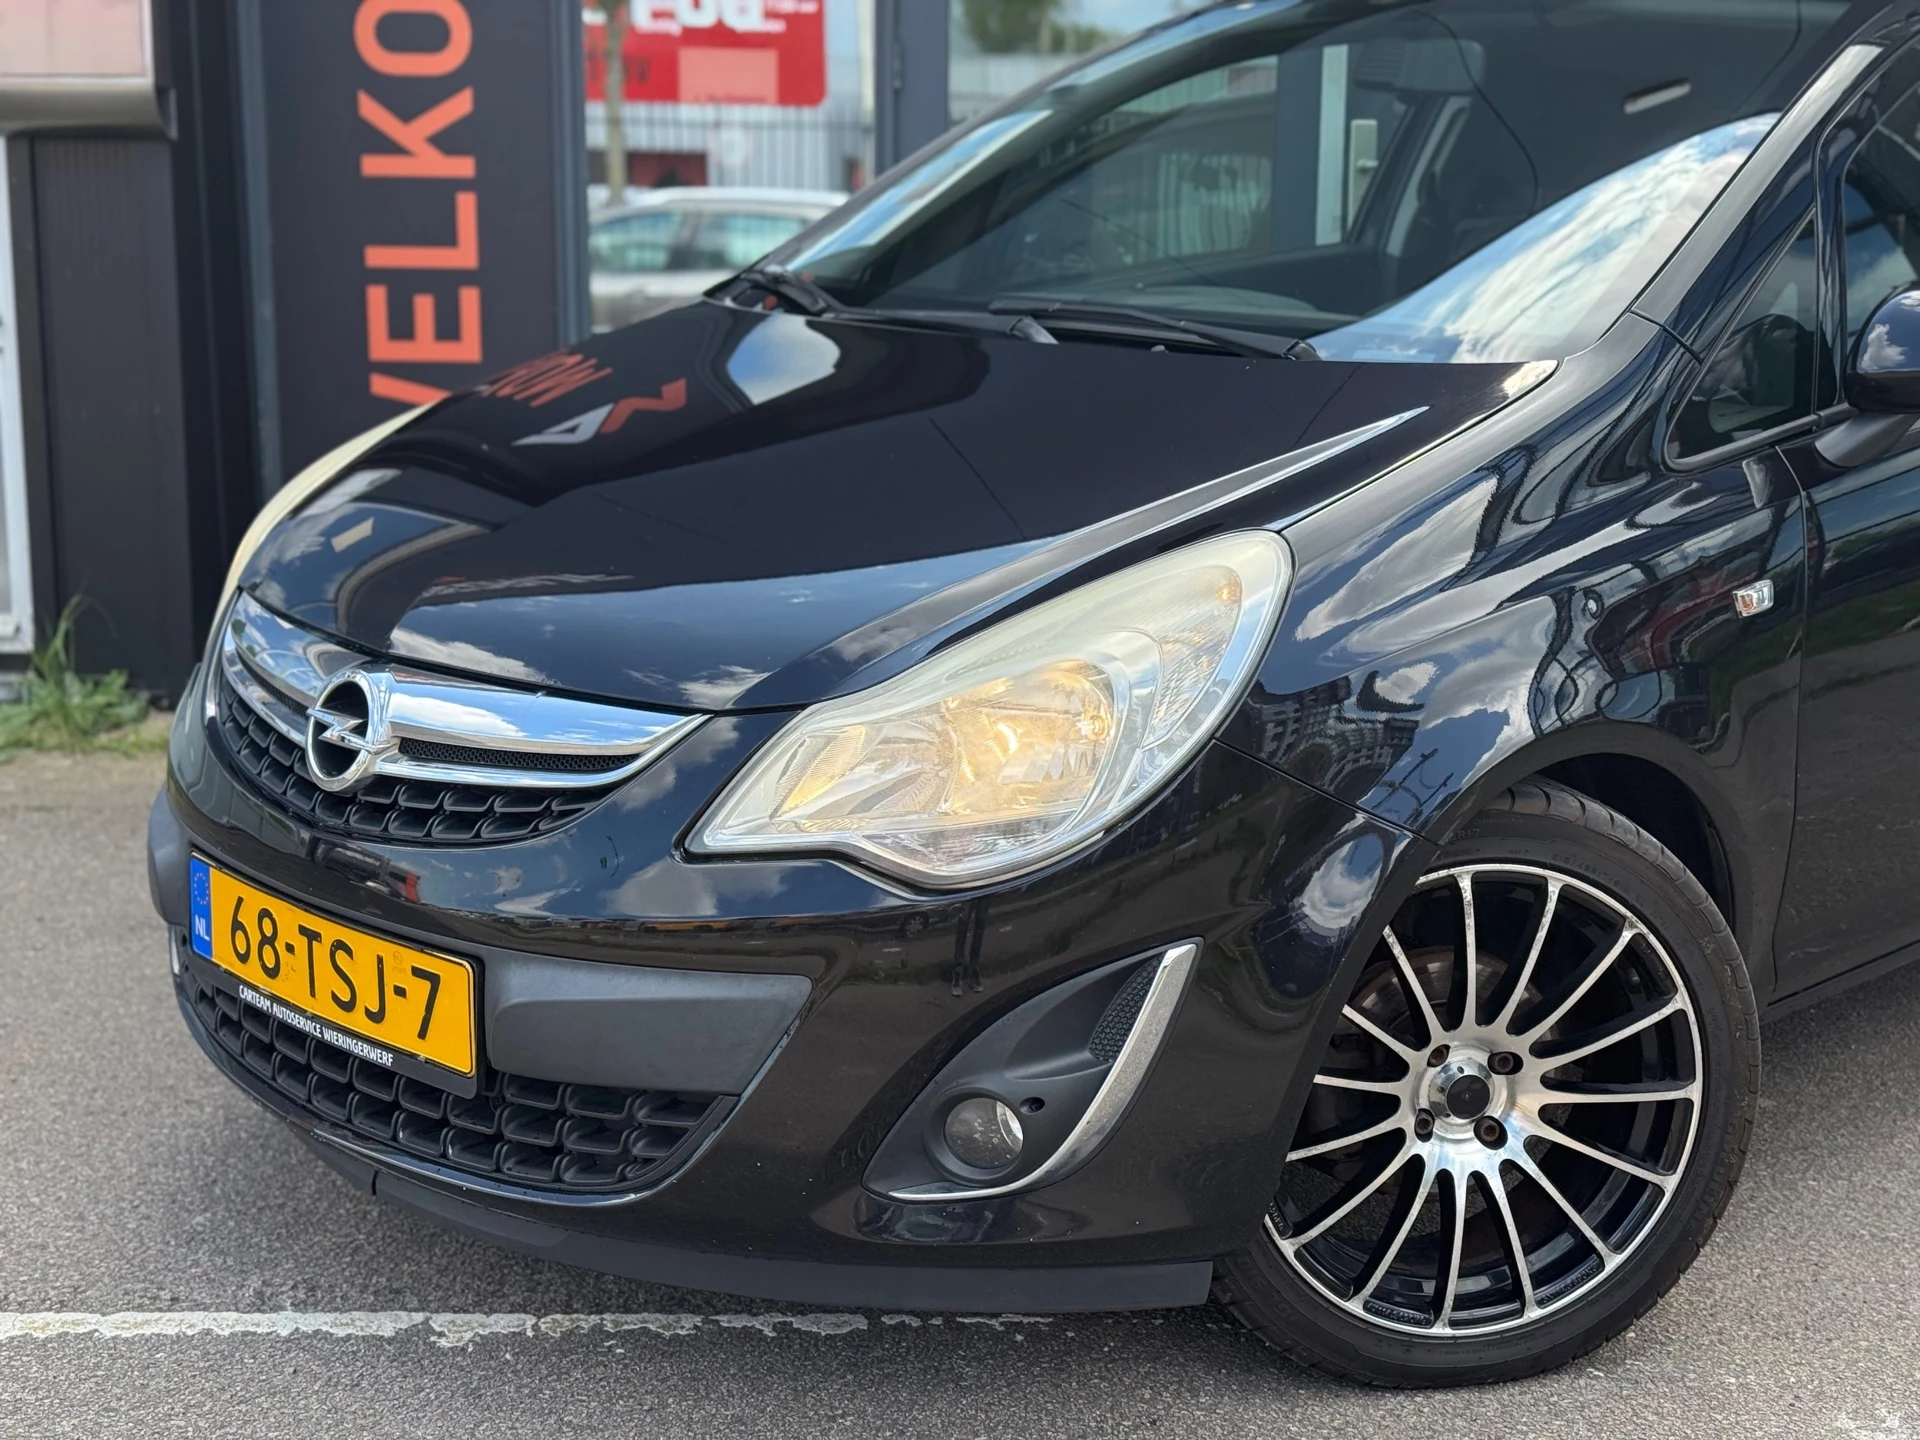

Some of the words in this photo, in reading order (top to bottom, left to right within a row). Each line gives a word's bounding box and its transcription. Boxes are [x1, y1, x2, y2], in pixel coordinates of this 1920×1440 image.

[194, 918, 210, 941] NL
[230, 895, 442, 1041] 68-TSJ-7
[239, 984, 272, 1014] CARTEAM
[272, 1004, 322, 1038] AUTOSERVICE
[322, 1026, 394, 1067] WIERINGERWERF
